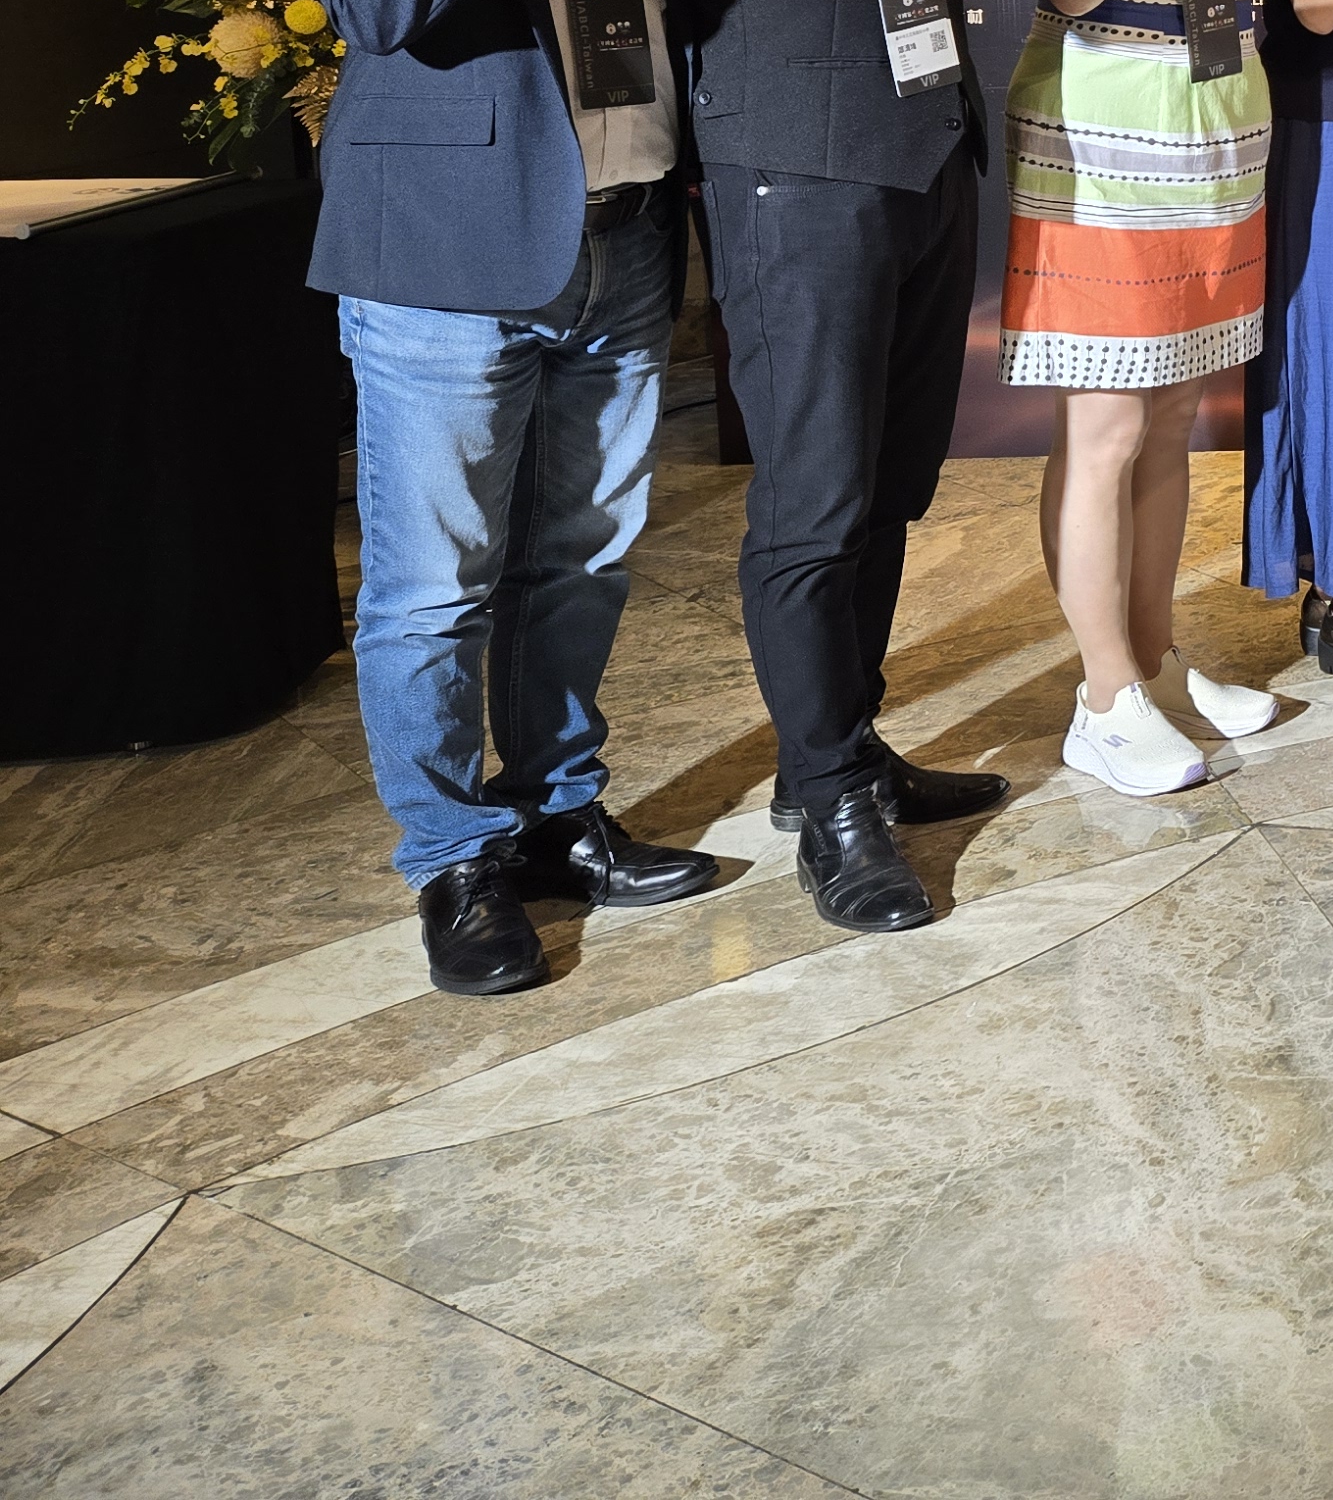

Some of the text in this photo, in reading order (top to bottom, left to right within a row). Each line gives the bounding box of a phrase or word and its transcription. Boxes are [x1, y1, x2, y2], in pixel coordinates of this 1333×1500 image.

[1209, 64, 1225, 76] VIP
[920, 73, 940, 87] VIP
[607, 90, 630, 103] VIP
